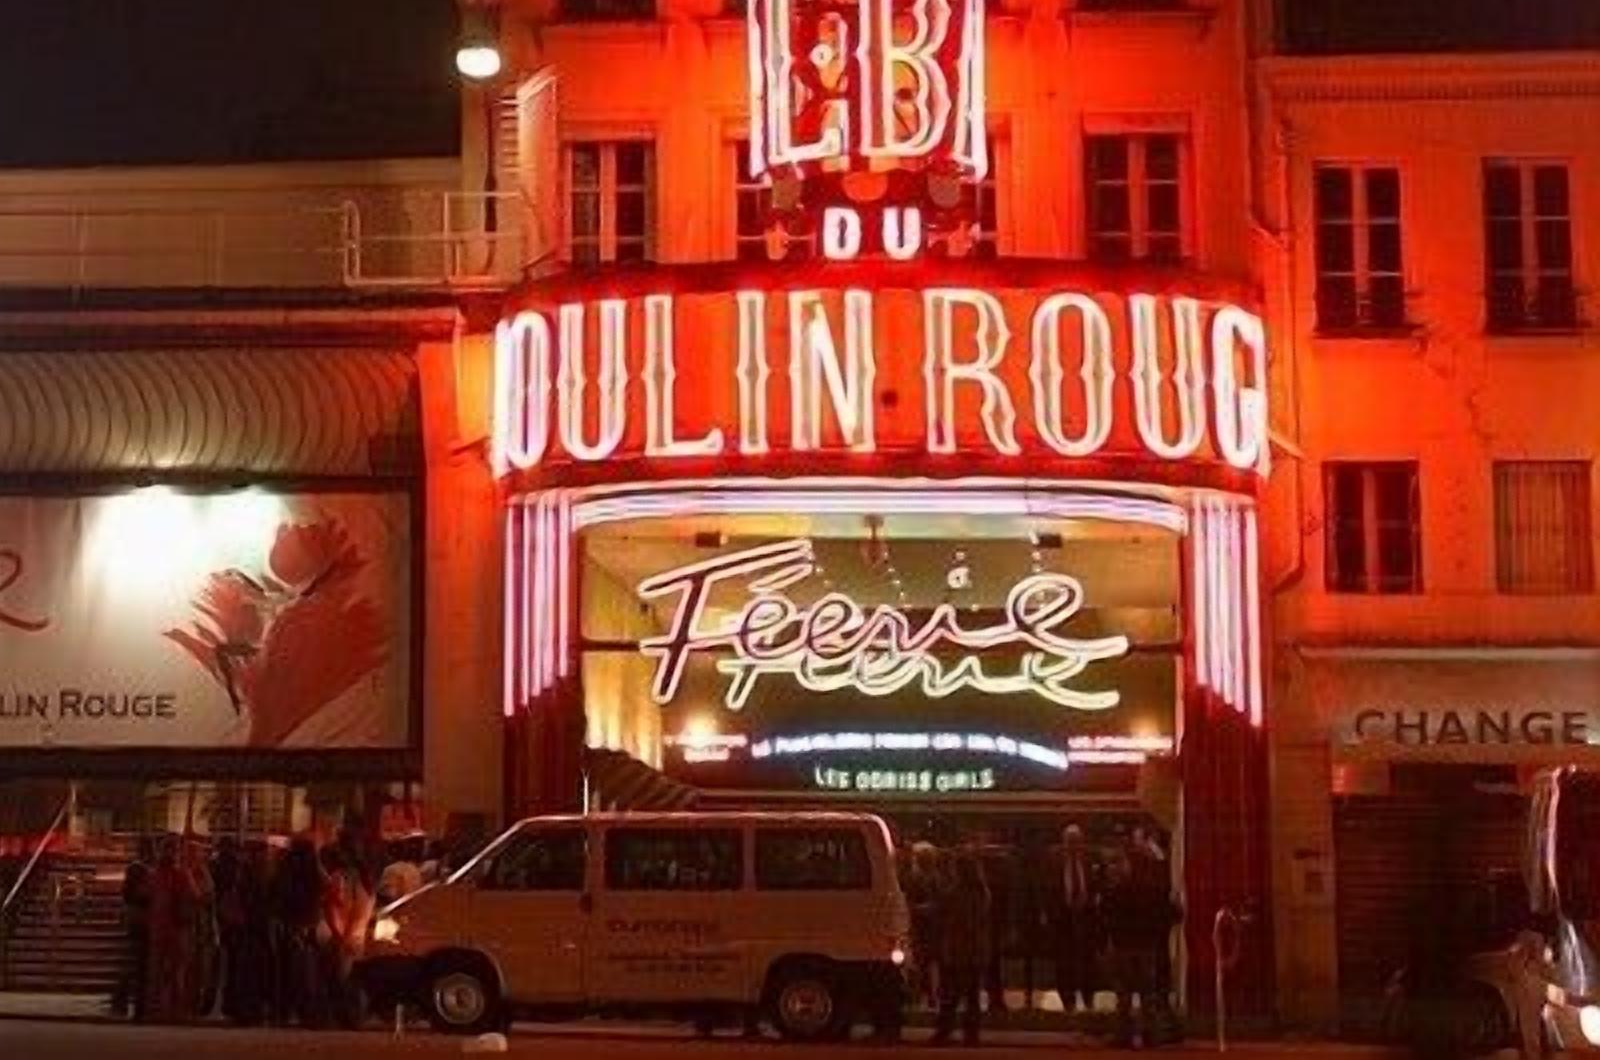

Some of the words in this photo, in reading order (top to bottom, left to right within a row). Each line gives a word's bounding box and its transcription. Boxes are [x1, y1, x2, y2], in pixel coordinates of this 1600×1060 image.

[823, 207, 921, 260] DU
[491, 290, 878, 481] OULIN
[923, 287, 1272, 480] ROUG
[58, 689, 177, 719] ROUGE
[1354, 708, 1590, 745] CHANGE
